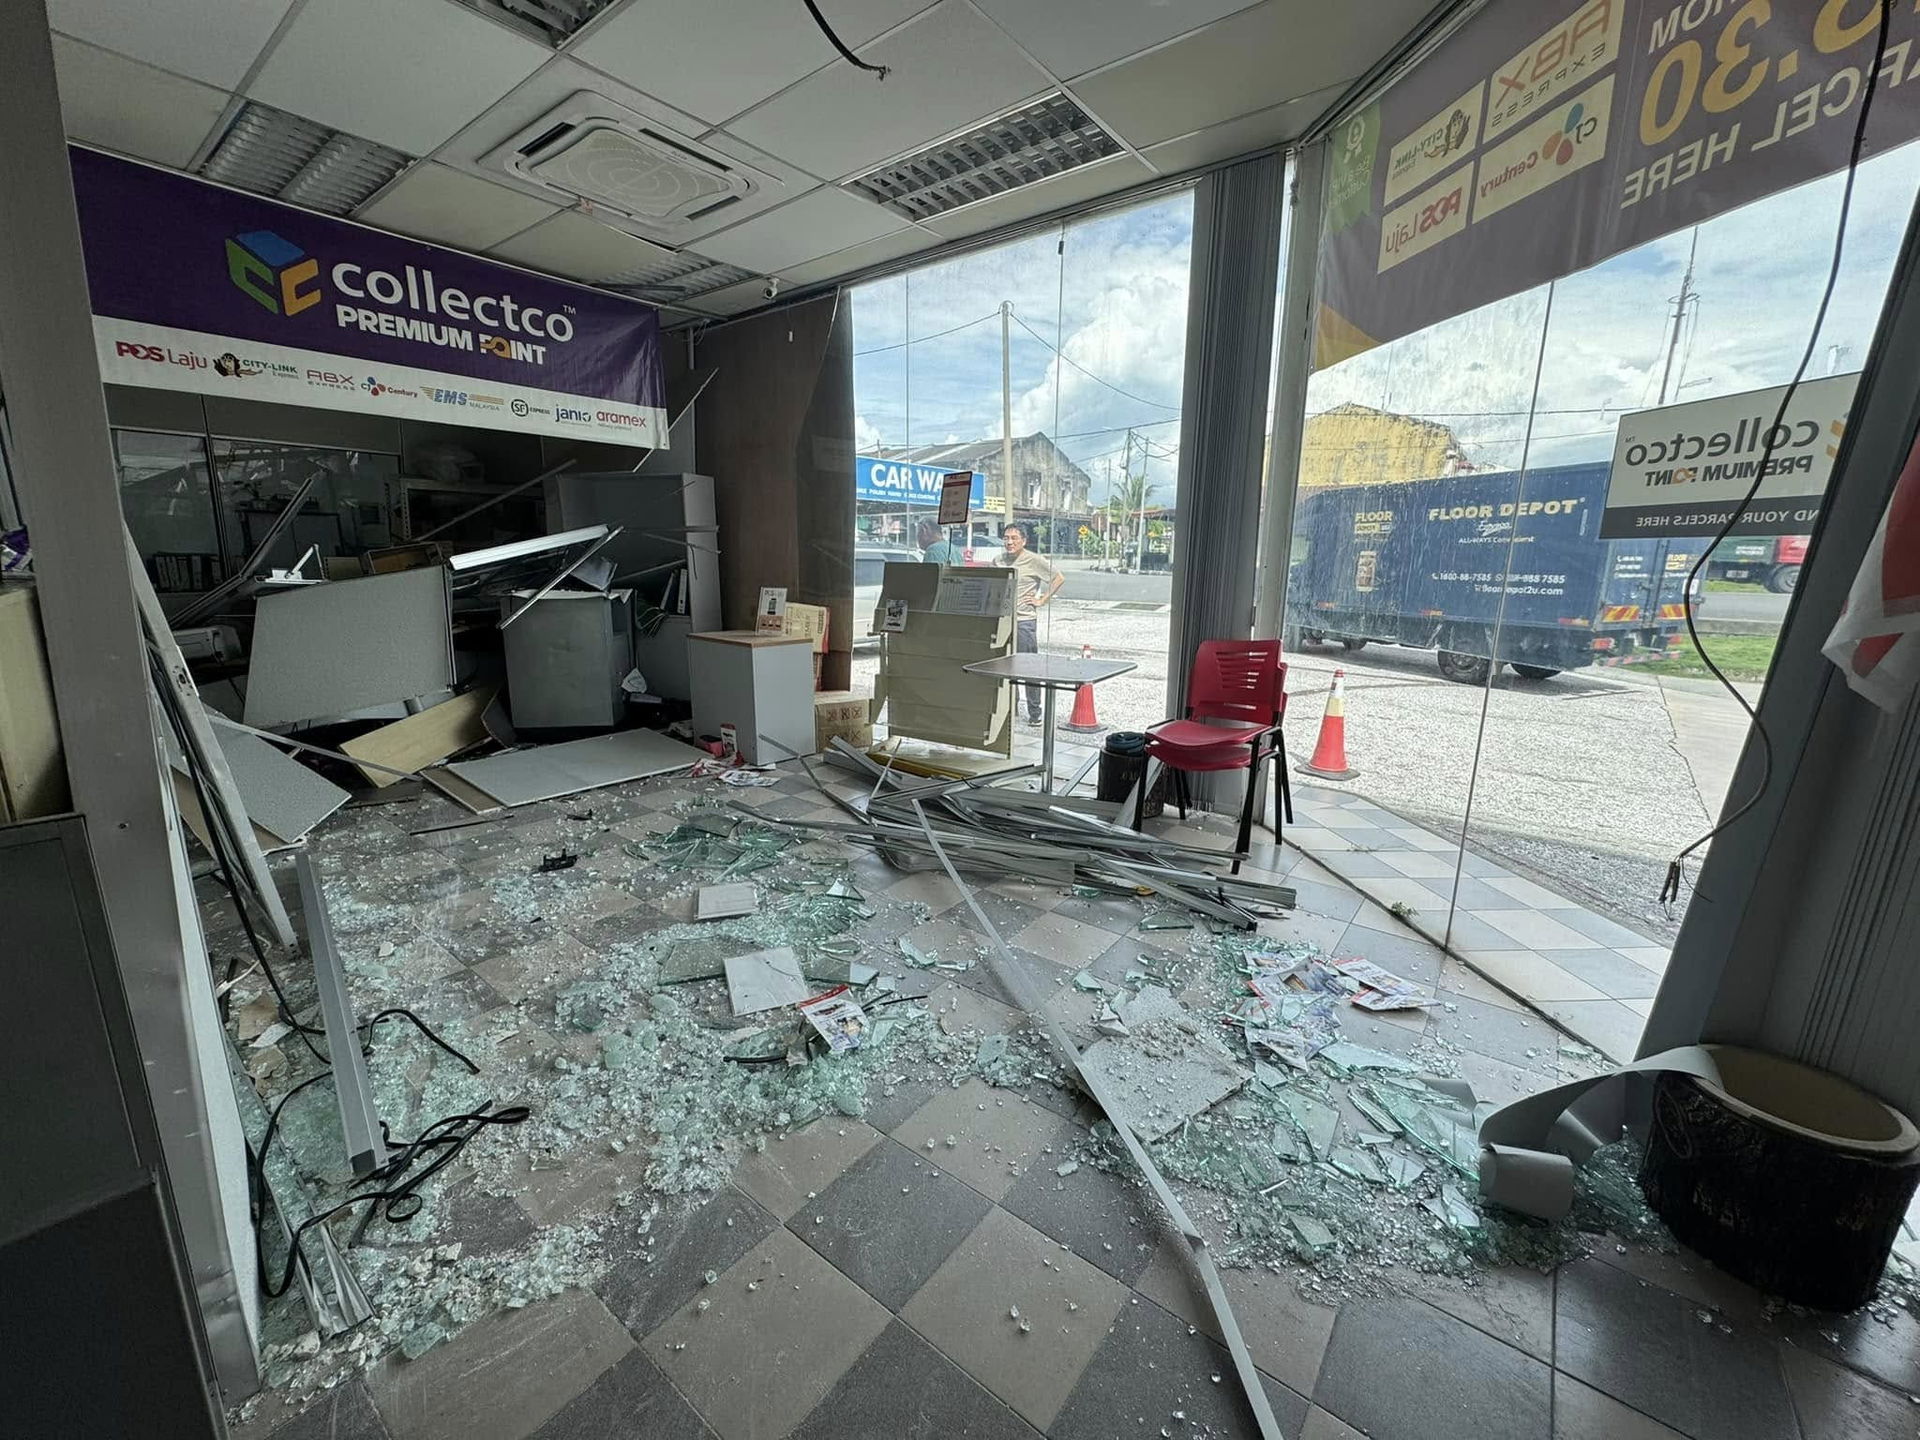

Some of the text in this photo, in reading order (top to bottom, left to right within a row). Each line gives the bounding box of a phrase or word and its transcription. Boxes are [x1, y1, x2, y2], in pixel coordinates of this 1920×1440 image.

[331, 263, 577, 343] collectco TM
[336, 304, 547, 365] PREMIUM POINT
[115, 341, 207, 370] POS Laju
[243, 359, 298, 374] CITY-LINK
[306, 369, 355, 386] ABX
[388, 386, 418, 398] Century
[434, 388, 468, 406] EMS
[513, 402, 526, 414] SF
[555, 403, 592, 423] janio
[596, 410, 647, 428] aramex
[871, 463, 913, 490] CAR
[1355, 510, 1393, 522] FLOOR
[1429, 499, 1578, 521] FLOOR DEPOT
[1543, 574, 1566, 584] 7585
